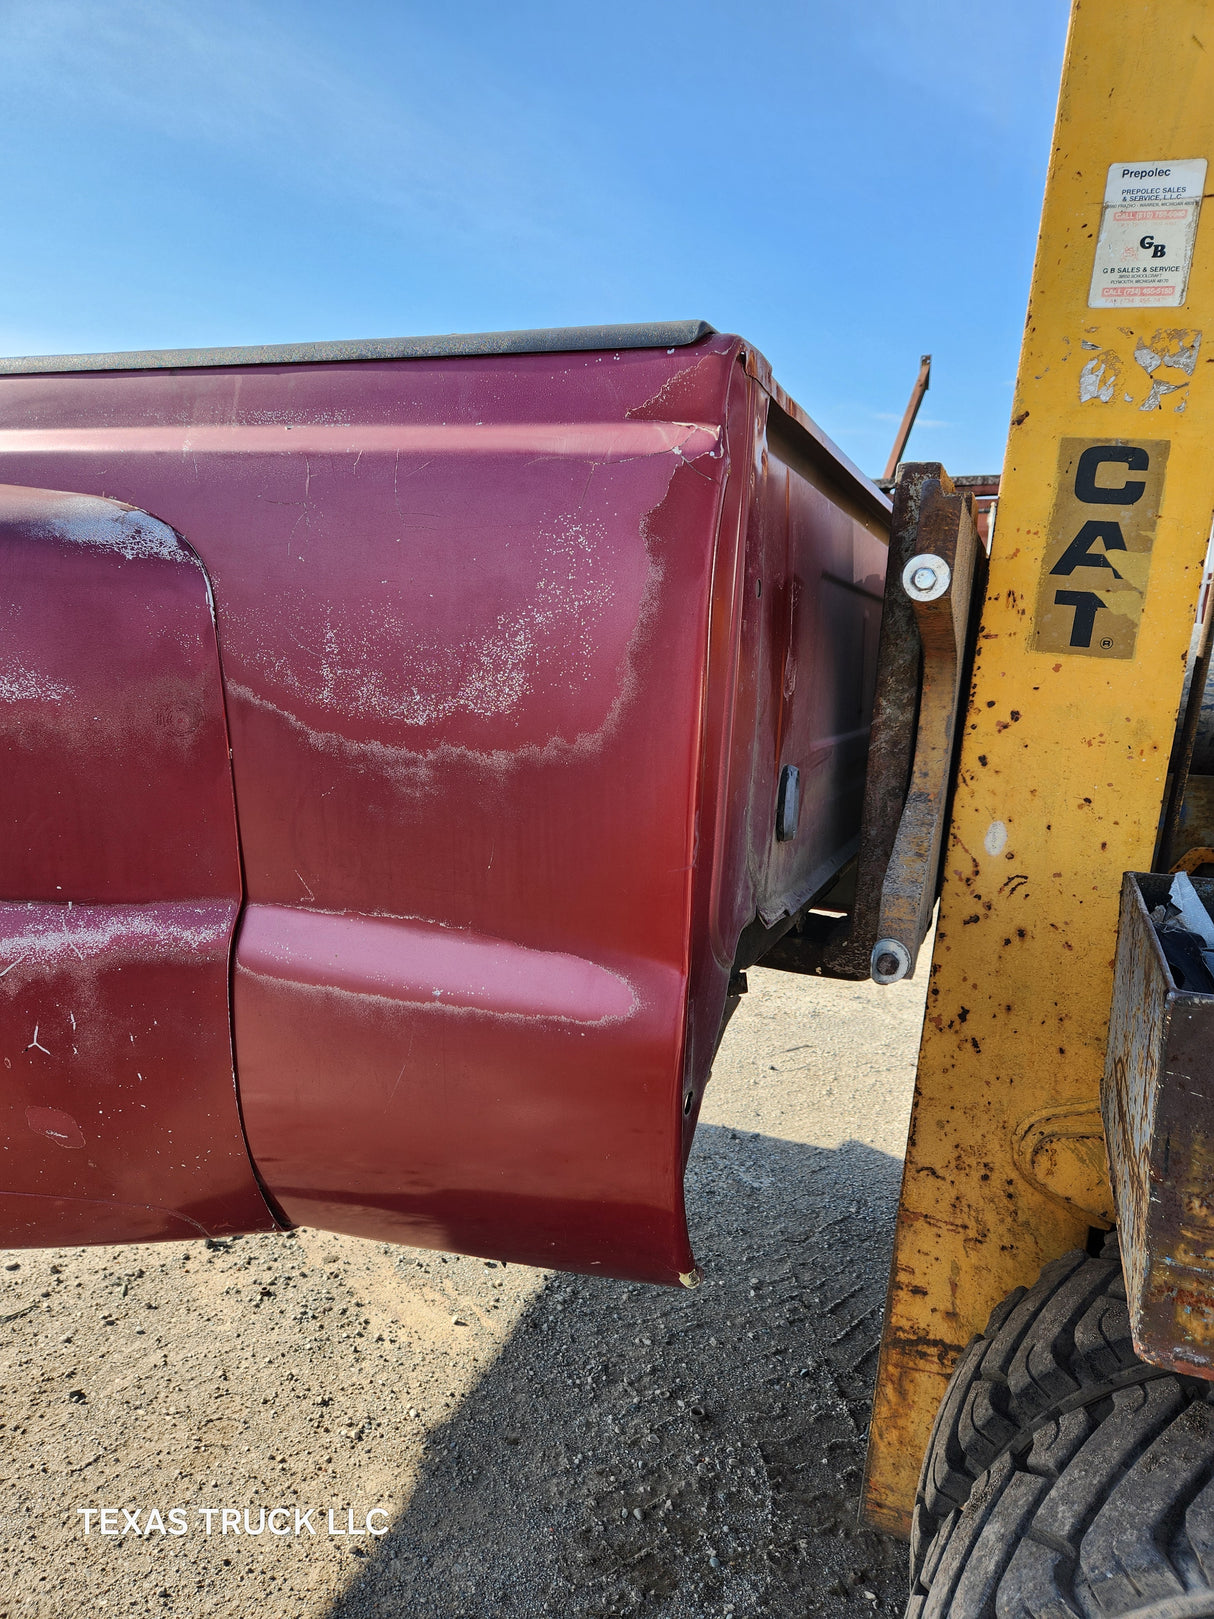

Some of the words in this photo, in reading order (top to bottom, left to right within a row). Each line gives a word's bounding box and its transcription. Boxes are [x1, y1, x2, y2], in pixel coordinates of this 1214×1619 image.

[1122, 168, 1171, 179] Prepolec
[1121, 187, 1160, 195] PREPOLEC
[1149, 265, 1180, 273] SERVICE
[1103, 288, 1122, 296] CALL
[1049, 445, 1149, 648] CAT
